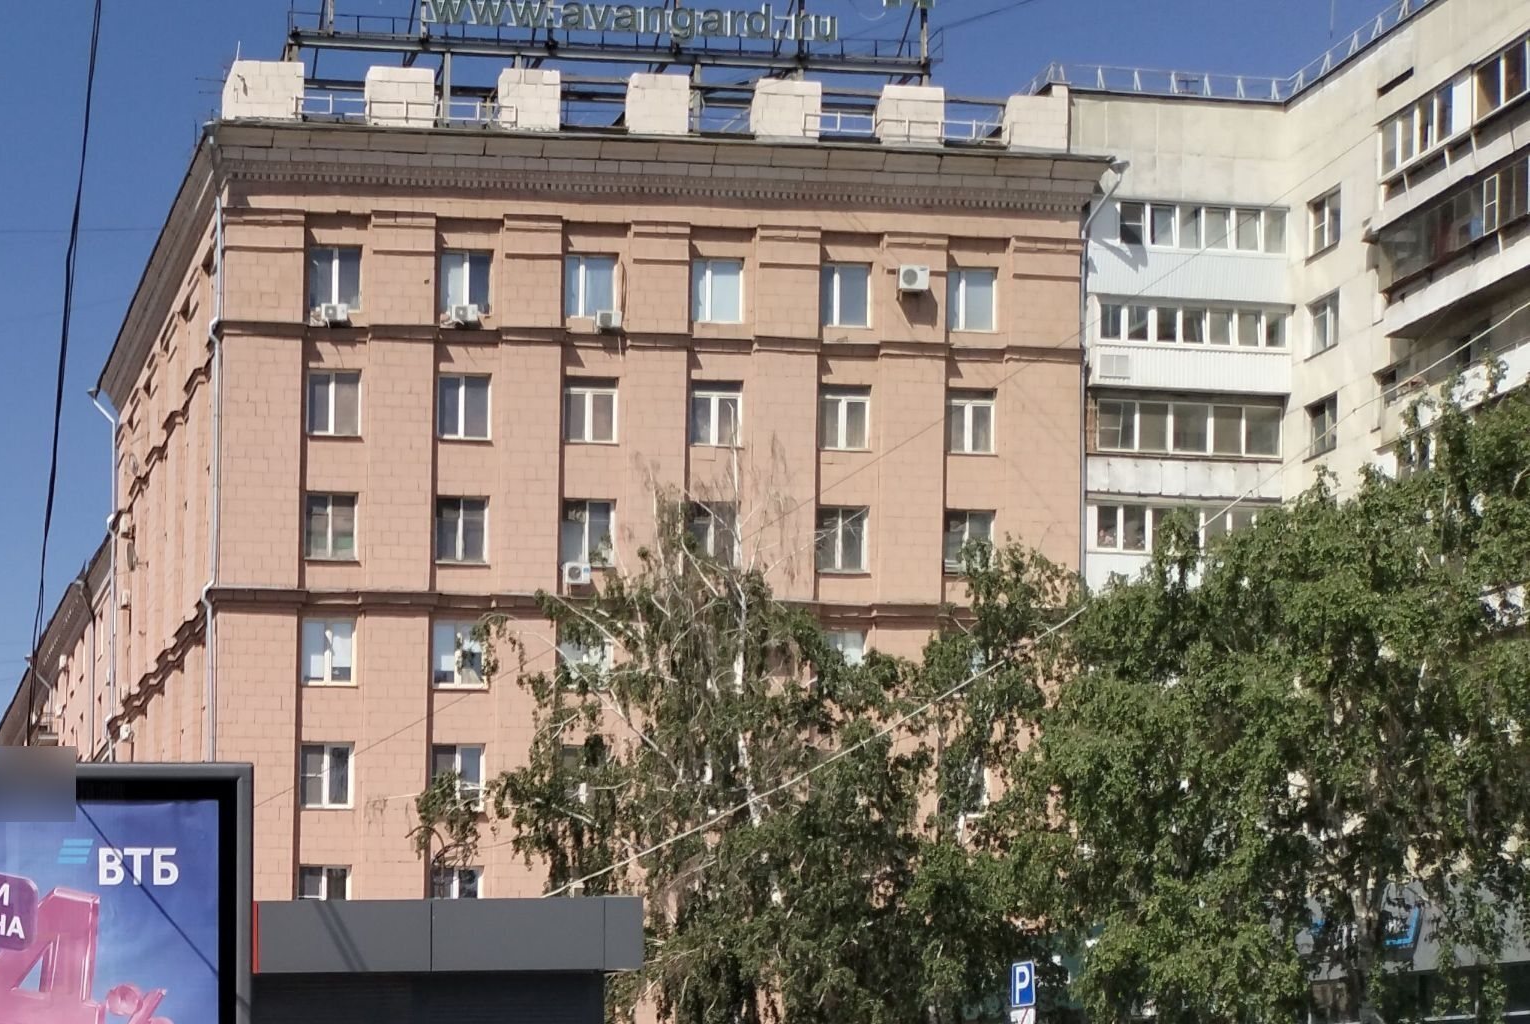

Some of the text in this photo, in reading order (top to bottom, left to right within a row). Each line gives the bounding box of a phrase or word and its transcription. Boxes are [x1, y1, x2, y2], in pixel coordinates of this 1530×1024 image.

[427, 0, 838, 41] www.avangard.ru
[98, 847, 179, 886] ВТБ
[1015, 966, 1030, 1005] P
